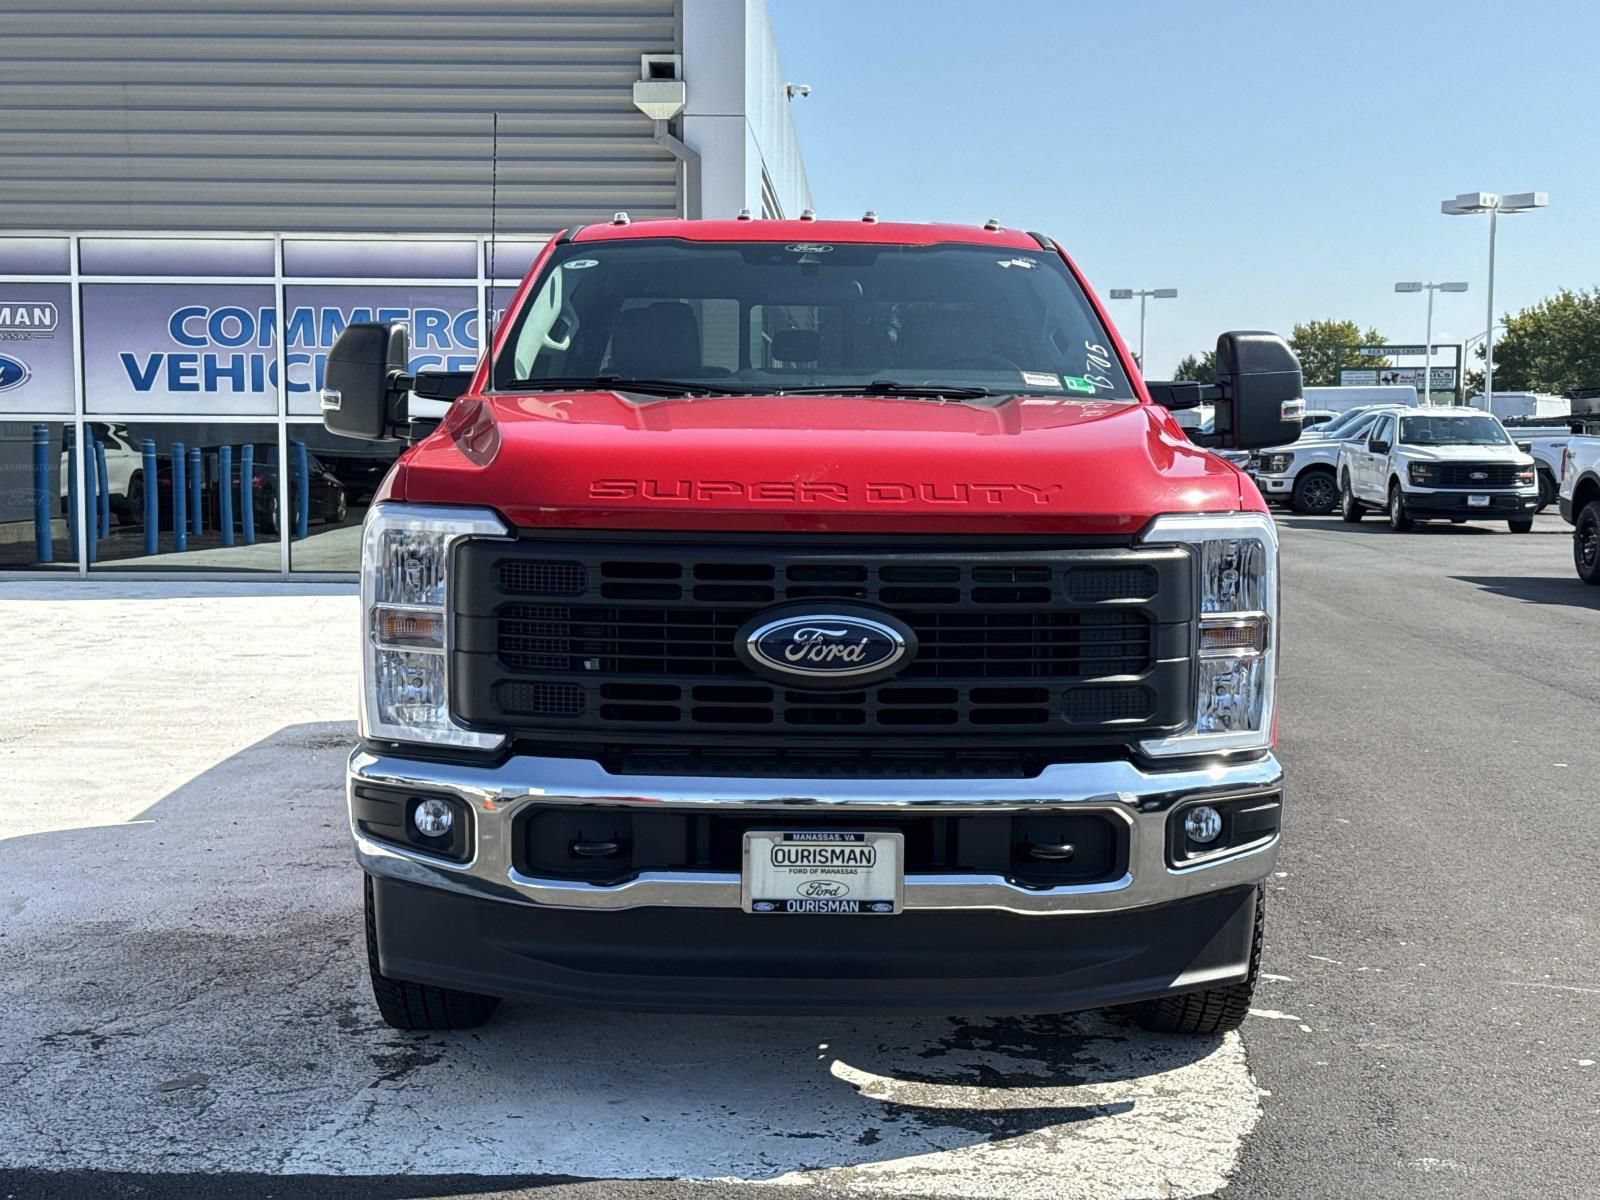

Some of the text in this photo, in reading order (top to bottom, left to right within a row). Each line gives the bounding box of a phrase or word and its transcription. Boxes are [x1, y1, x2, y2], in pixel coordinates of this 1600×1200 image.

[589, 479, 1063, 504] SUPER DUTY
[785, 627, 868, 662] Ford
[844, 833, 855, 841] VA
[774, 848, 872, 864] OURISMAN
[805, 882, 840, 897] Ford
[786, 900, 859, 913] OURISMAN
